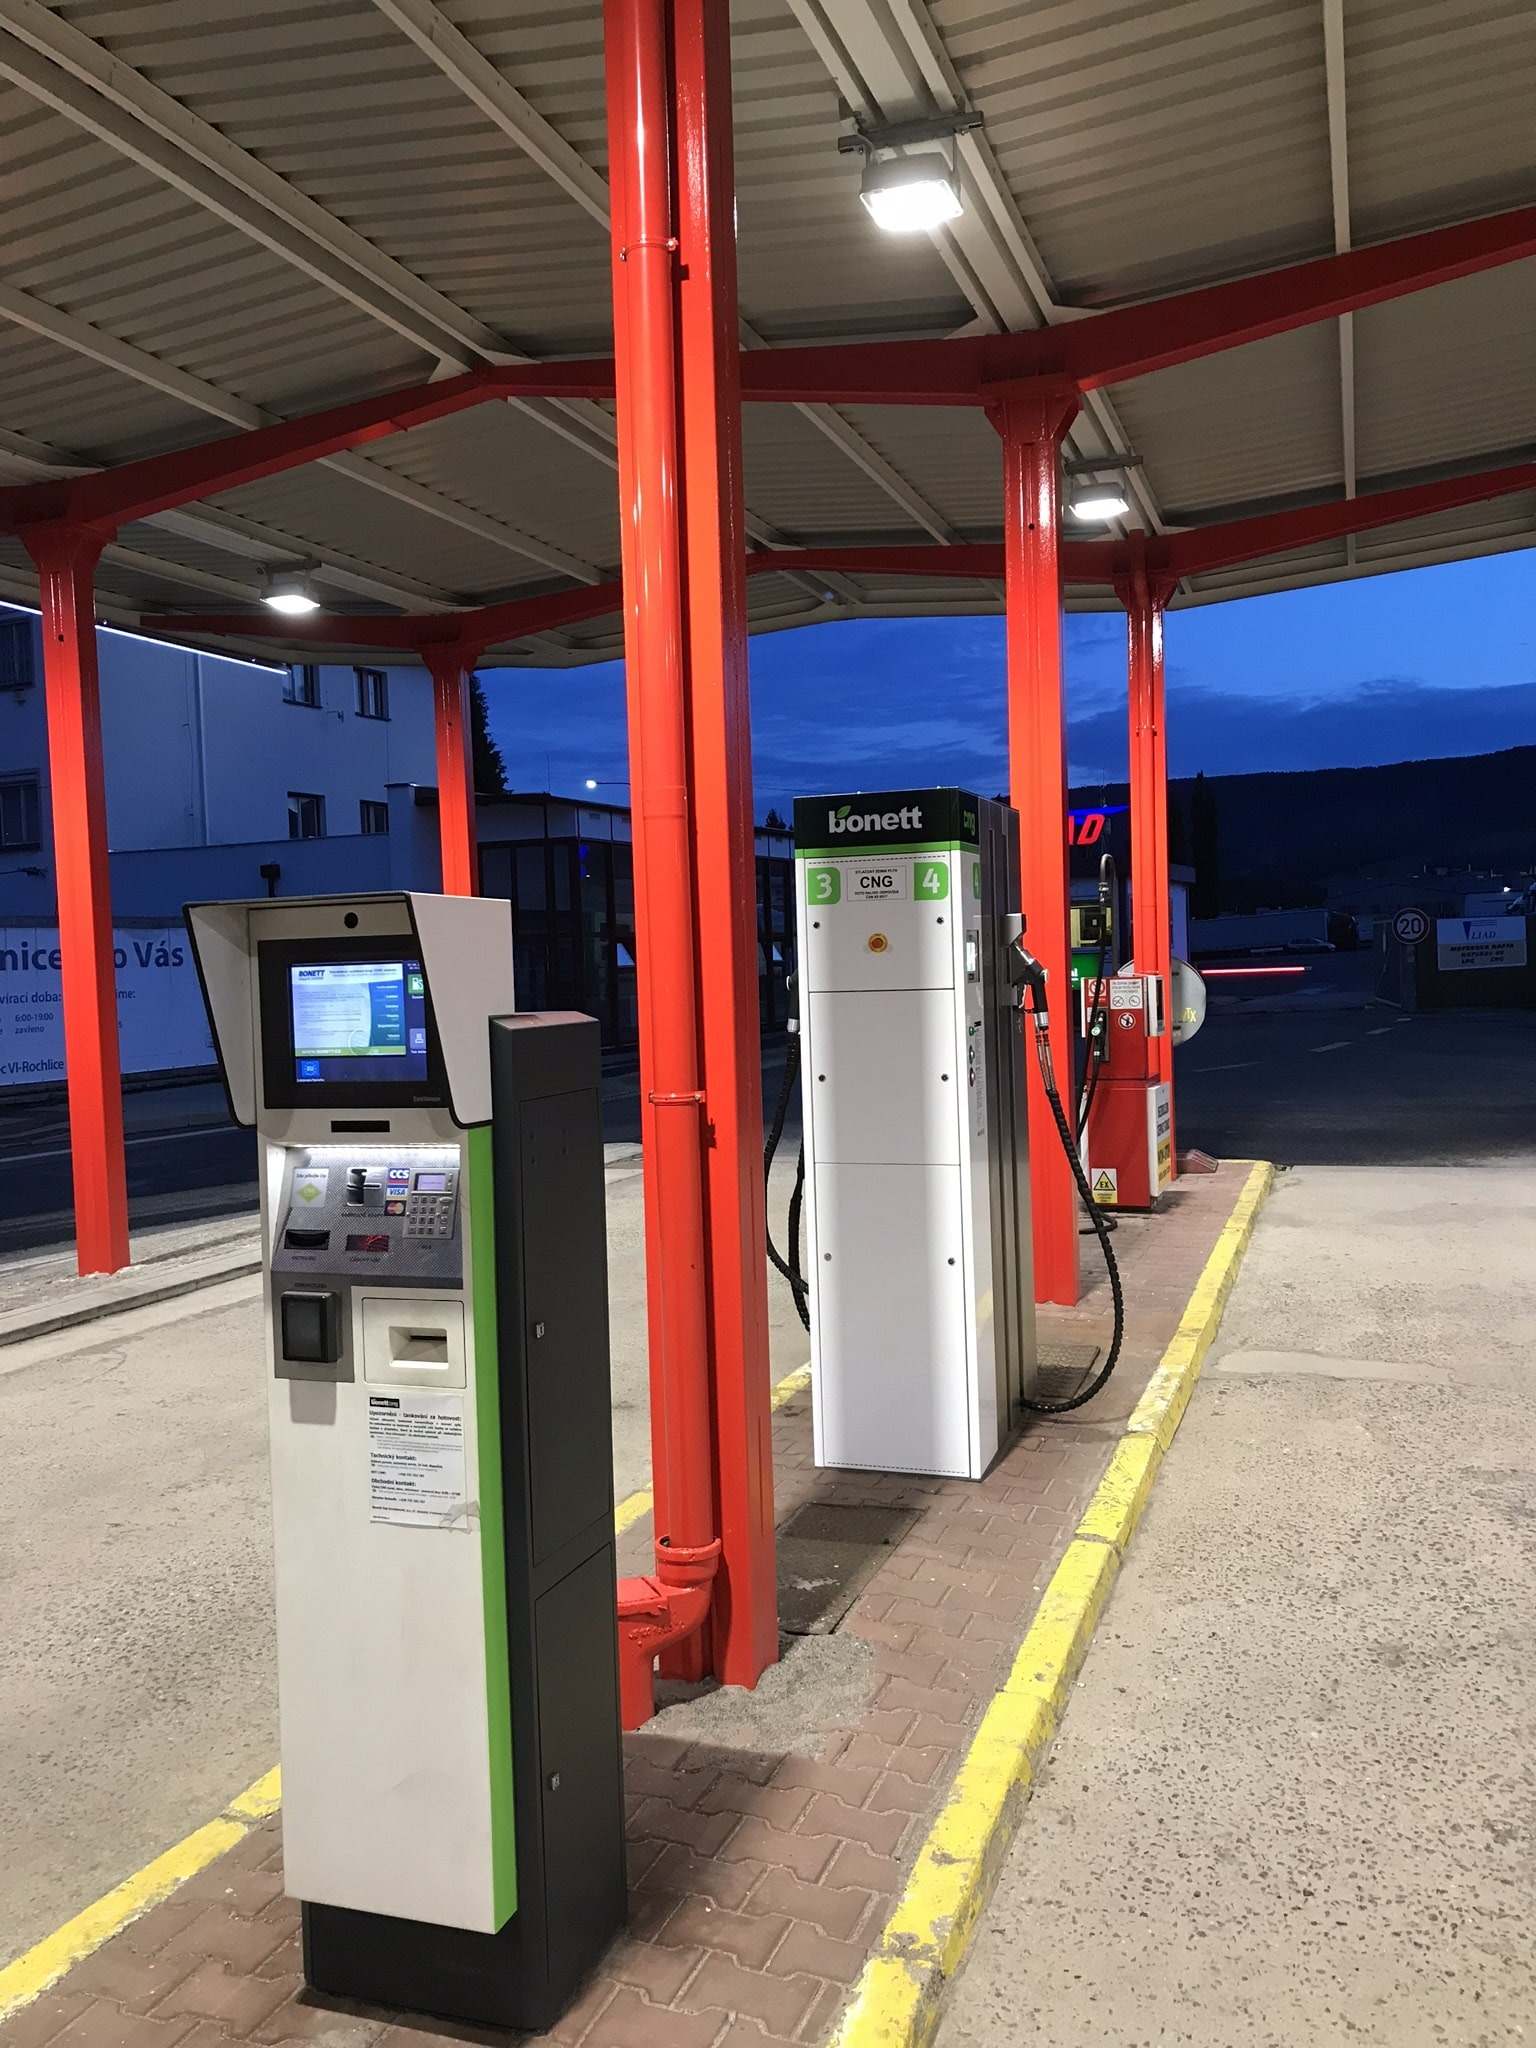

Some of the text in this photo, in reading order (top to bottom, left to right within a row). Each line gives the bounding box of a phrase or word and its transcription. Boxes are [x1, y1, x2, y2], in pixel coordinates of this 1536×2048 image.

[829, 805, 923, 834] bonett
[816, 873, 833, 899] 3
[860, 875, 893, 889] CNG
[922, 867, 941, 894] 4
[1400, 917, 1422, 935] 20
[132, 940, 184, 968] Vás
[31, 990, 62, 1002] doba:
[389, 1169, 410, 1179] CCS
[389, 1188, 406, 1196] VISA
